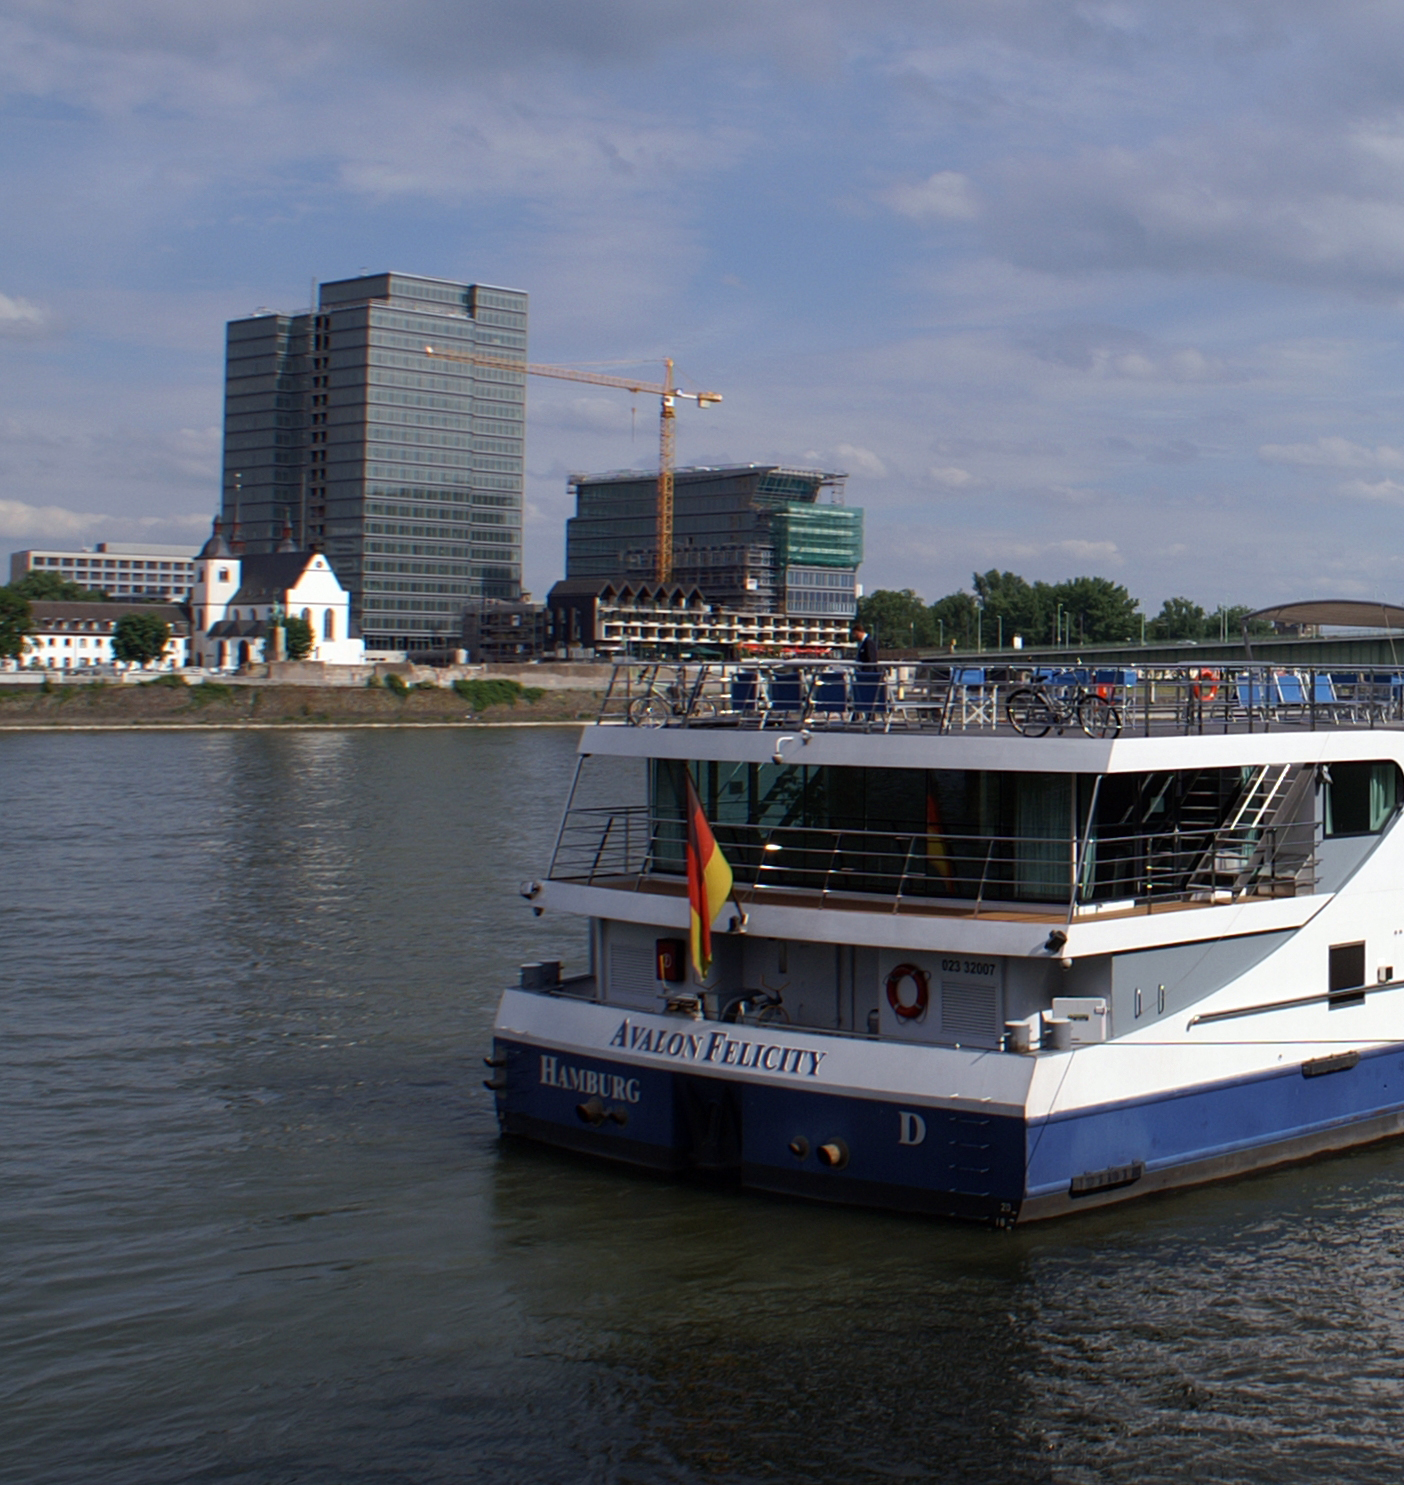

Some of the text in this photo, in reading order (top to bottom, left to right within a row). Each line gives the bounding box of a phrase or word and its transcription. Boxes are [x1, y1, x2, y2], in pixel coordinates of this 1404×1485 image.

[941, 958, 996, 976] 023 32007
[608, 1016, 828, 1077] AVALON FELICITY
[540, 1053, 641, 1104] HAMBURG
[898, 1110, 927, 1146] D
